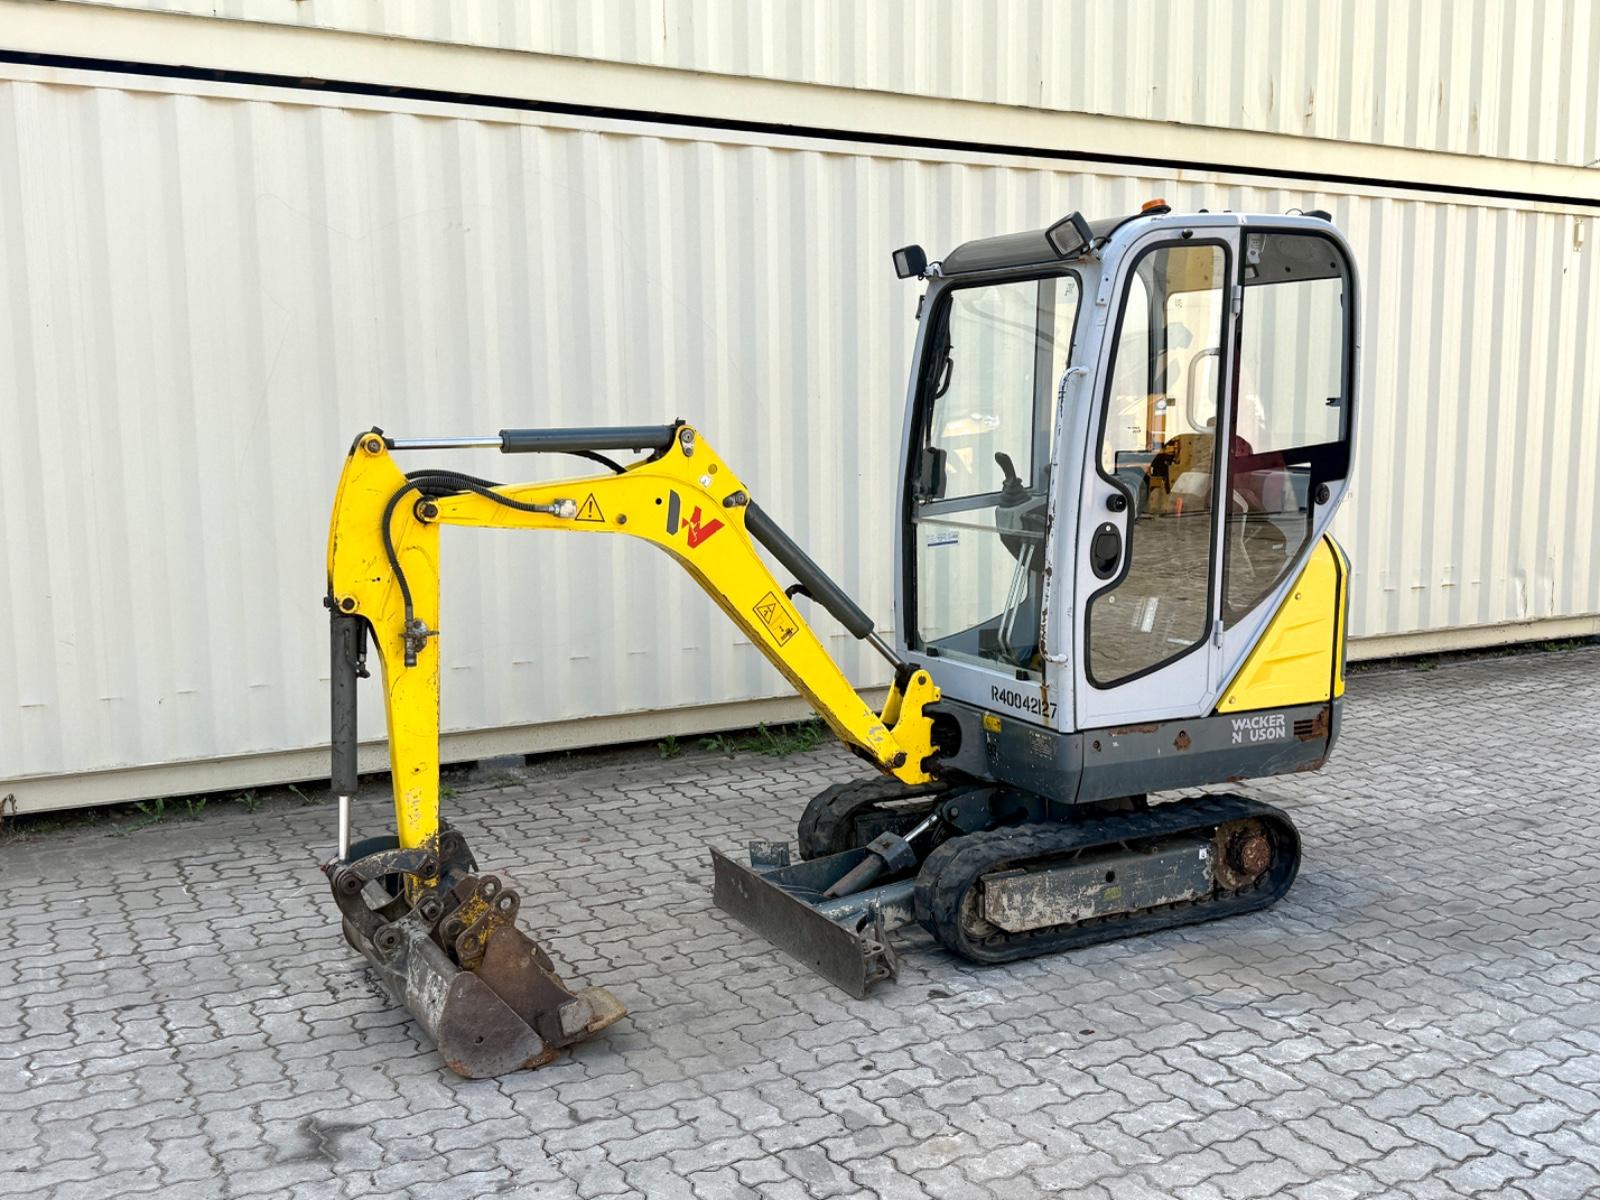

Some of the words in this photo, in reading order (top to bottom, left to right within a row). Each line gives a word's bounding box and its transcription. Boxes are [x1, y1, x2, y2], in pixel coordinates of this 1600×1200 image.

[991, 685, 1057, 719] R40042127
[1231, 713, 1286, 731] WACKER
[1231, 726, 1286, 744] NUSON
